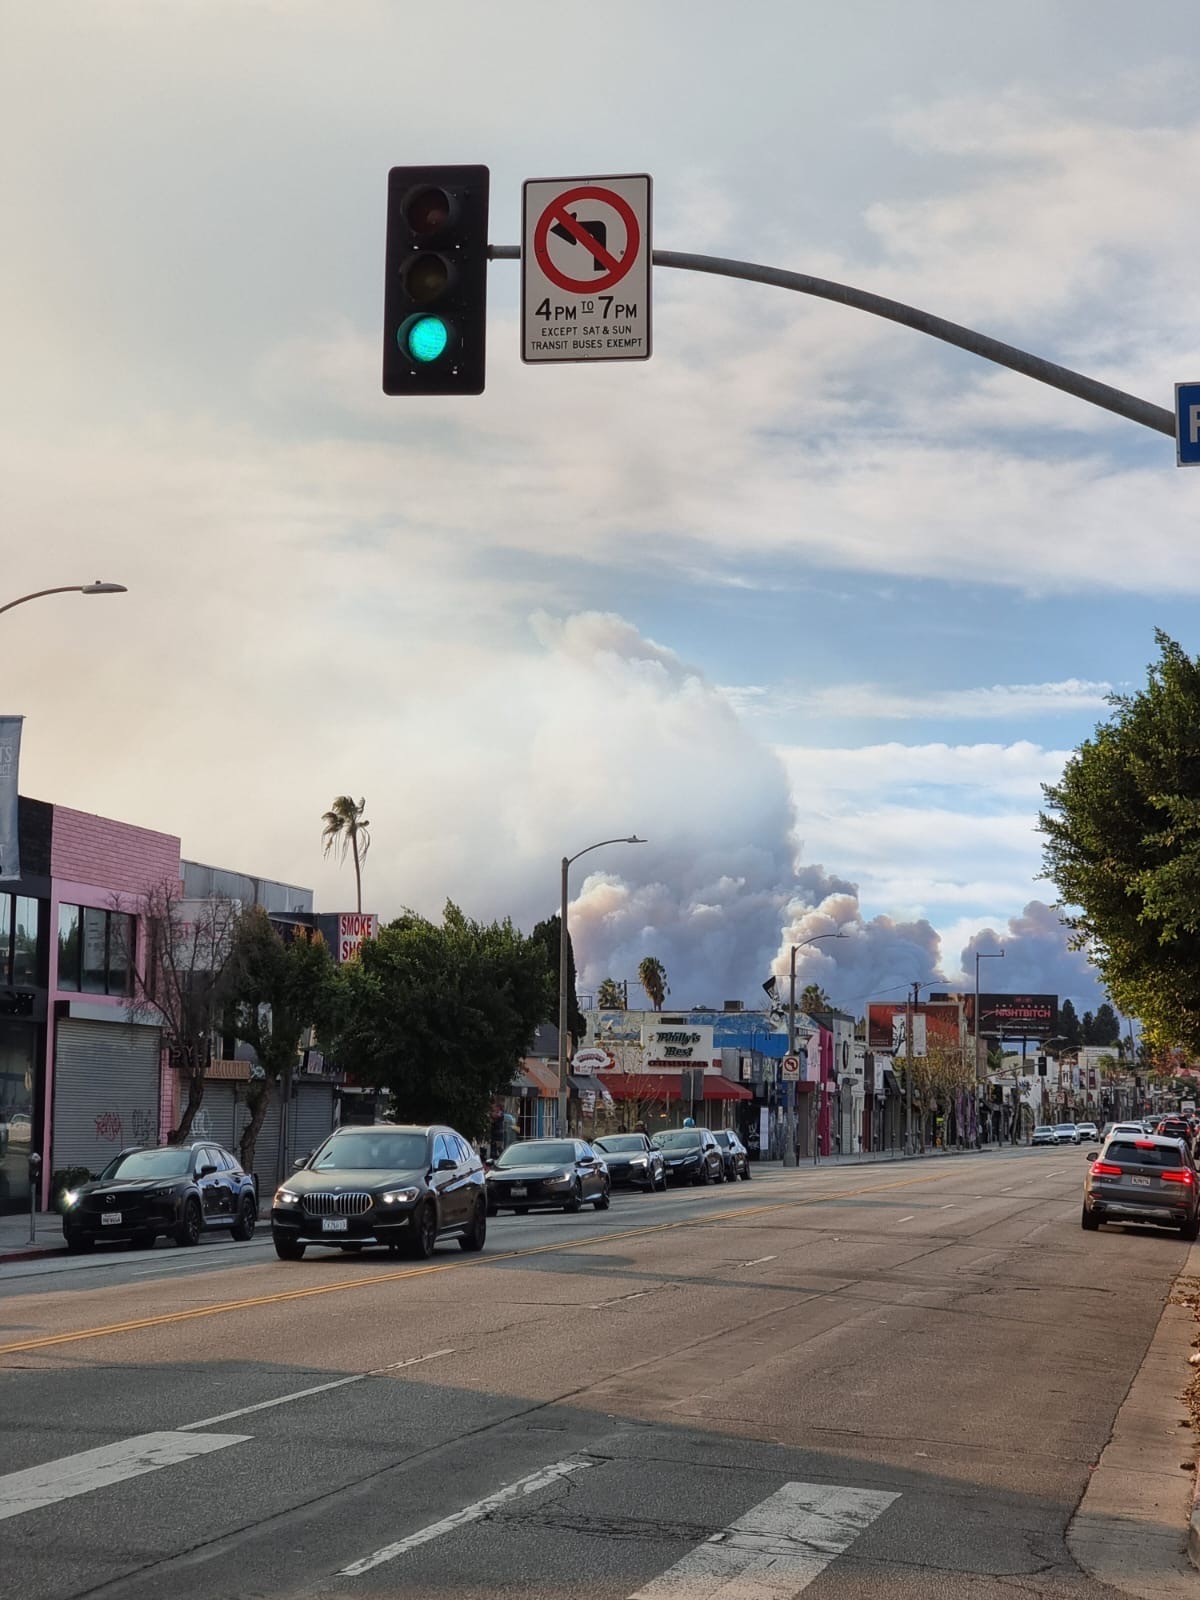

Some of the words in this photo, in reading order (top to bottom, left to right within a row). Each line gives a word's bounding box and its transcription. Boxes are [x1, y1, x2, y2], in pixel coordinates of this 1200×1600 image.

[535, 298, 577, 321] 4PM
[581, 301, 594, 313] TO
[598, 296, 637, 319] 7PM
[541, 327, 577, 337] EXCEPT
[583, 326, 600, 336] SAT
[602, 326, 610, 335] &
[612, 325, 632, 335] SUN
[531, 340, 568, 350] TRANSIT
[572, 339, 603, 349] BUSES
[607, 338, 642, 348] EXEMPT
[341, 916, 372, 937] SMOKE
[995, 1008, 1051, 1018] NIGHTBITCH
[656, 1032, 701, 1046] Philly's
[664, 1046, 694, 1057] Best
